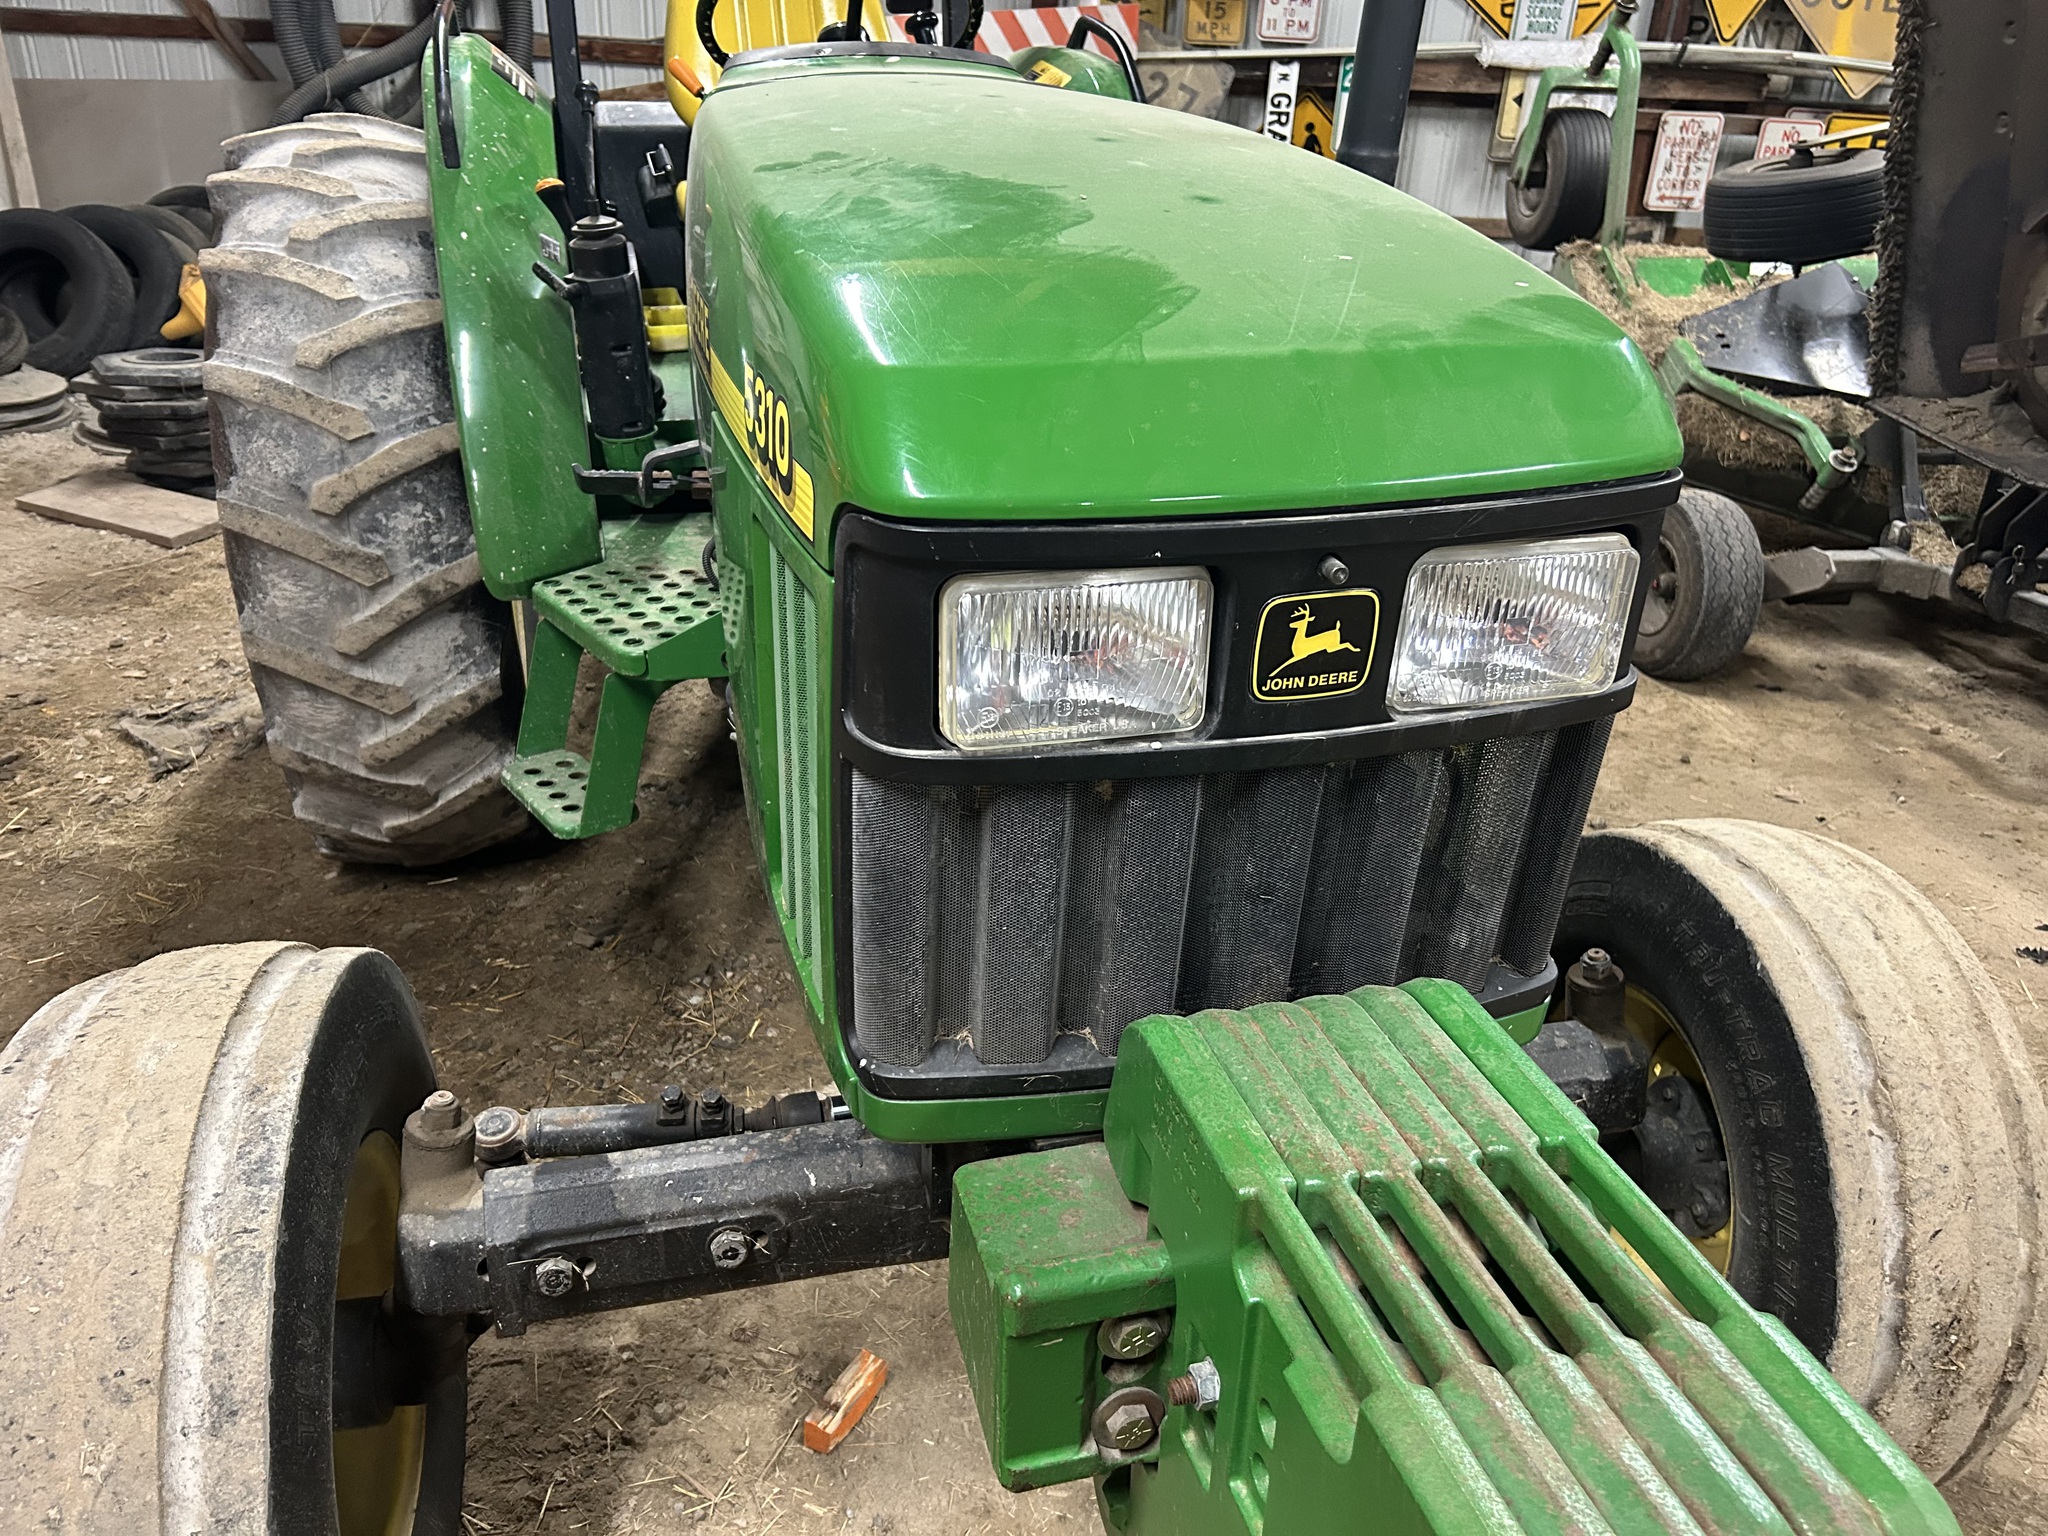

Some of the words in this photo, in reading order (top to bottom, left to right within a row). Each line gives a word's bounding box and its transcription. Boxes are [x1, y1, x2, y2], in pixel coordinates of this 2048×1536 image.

[1206, 1, 1226, 19] 15
[1282, 7, 1296, 18] TO
[1525, 5, 1562, 20] SCHOOL
[1196, 21, 1231, 35] MPH
[1285, 19, 1310, 32] PM
[1527, 20, 1558, 34] HOURS
[1682, 120, 1701, 135] NO
[1782, 129, 1801, 143] NO
[744, 360, 791, 482] 5310
[1261, 676, 1305, 691] JOHN
[1308, 670, 1358, 687] DEERE
